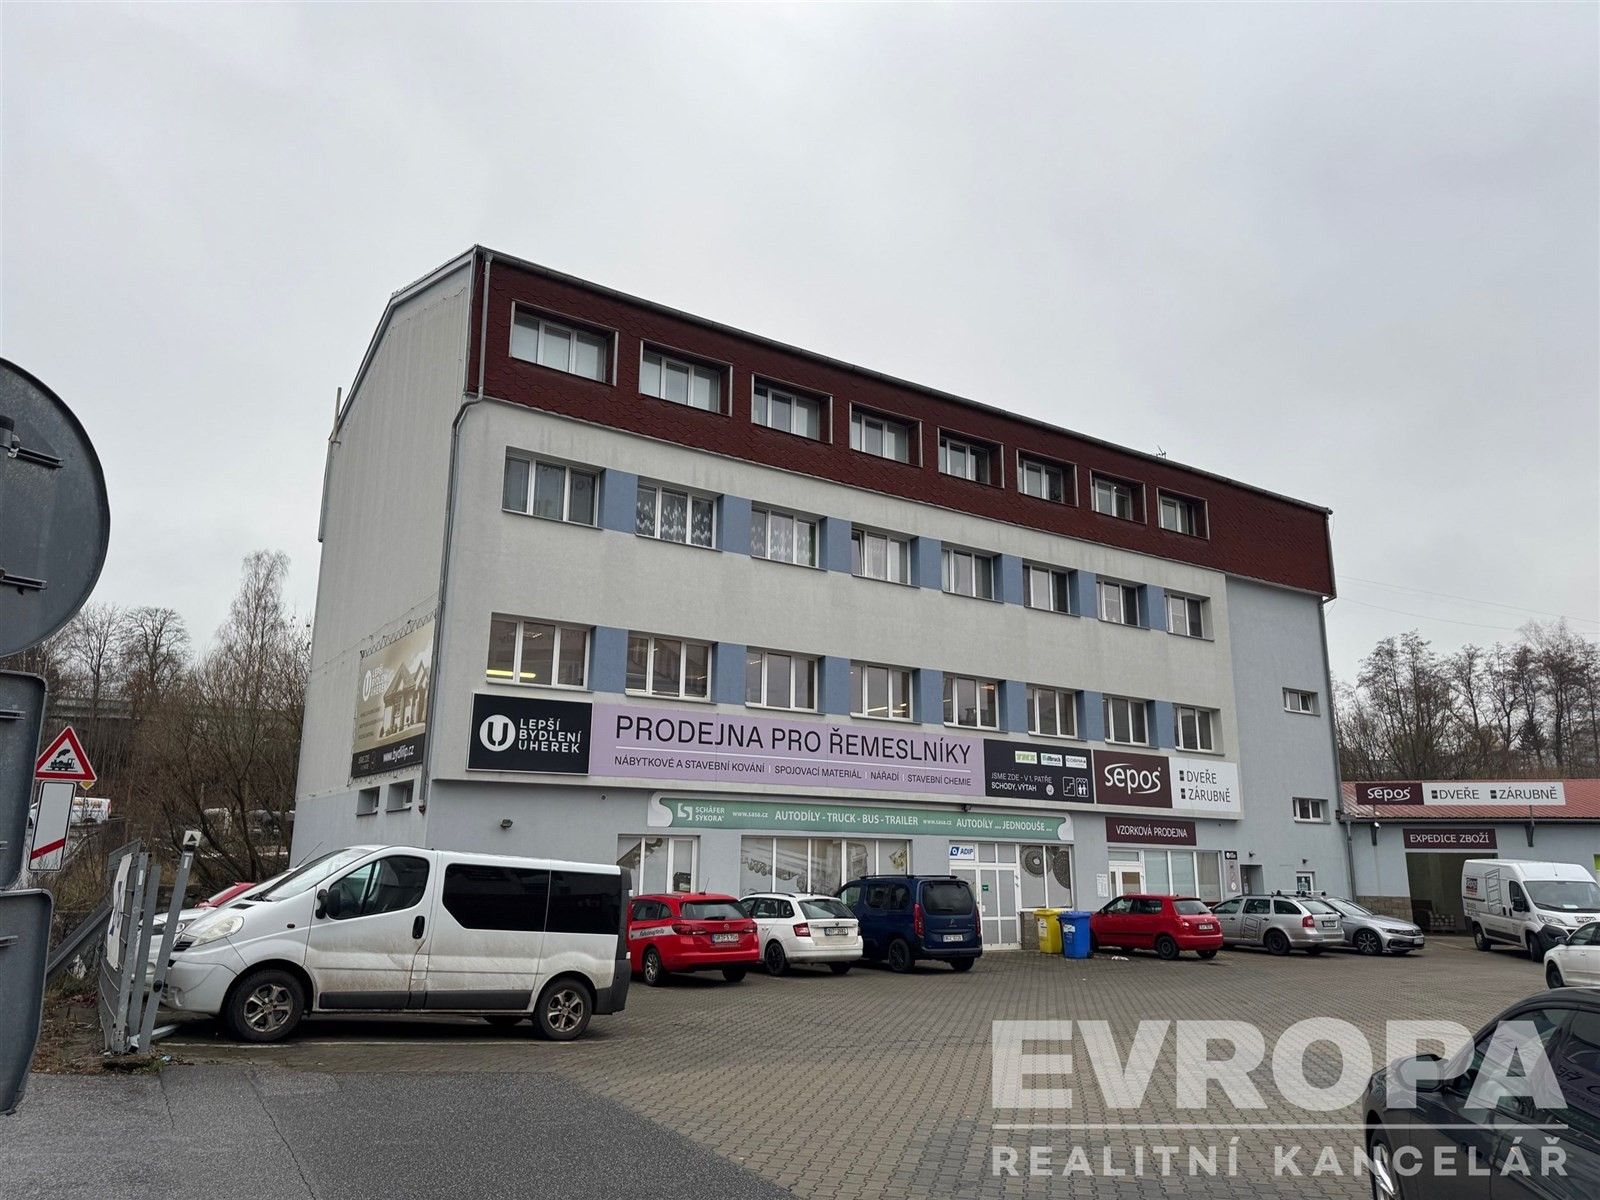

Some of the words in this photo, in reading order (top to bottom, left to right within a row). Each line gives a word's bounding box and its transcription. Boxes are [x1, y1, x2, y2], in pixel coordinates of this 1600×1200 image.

[519, 717, 561, 731] LEPŠÍ
[518, 729, 583, 744] BYDLENÍ
[615, 714, 764, 749] PRODEJNA
[771, 727, 822, 753] PRO
[829, 727, 971, 765] ŘEMESLNÍKY
[517, 739, 581, 754] UHEREK
[614, 754, 674, 768] NÁBYTKOVÉ
[675, 759, 683, 769] A
[684, 759, 731, 771] STAVEBNÍ
[731, 761, 765, 773] KOVÁNÍ
[774, 764, 821, 777] SPOJOVACÍ
[821, 766, 862, 779] MATERIÁL
[870, 769, 900, 782] NÁŘADÍ
[907, 773, 943, 785] STAVEBNÍ
[943, 776, 972, 786] CHEMIE
[1186, 769, 1217, 785] DVEŘE
[1188, 786, 1231, 803] ZÁRUBNĚ
[1439, 787, 1480, 800] DVEŘE
[1499, 786, 1558, 800] ZÁRUBNĚ
[775, 809, 821, 822] AUTODÍLY
[827, 812, 855, 823] TRUCK
[862, 815, 879, 825] BUS
[885, 815, 919, 826] TRAILER
[956, 818, 993, 829] AUTODÍLY
[1115, 824, 1153, 837] VZORKOVÁ
[1153, 827, 1188, 838] PRODEJNA
[1410, 833, 1457, 843] EXPEDICE
[1459, 832, 1489, 843] ZBOŽÍ
